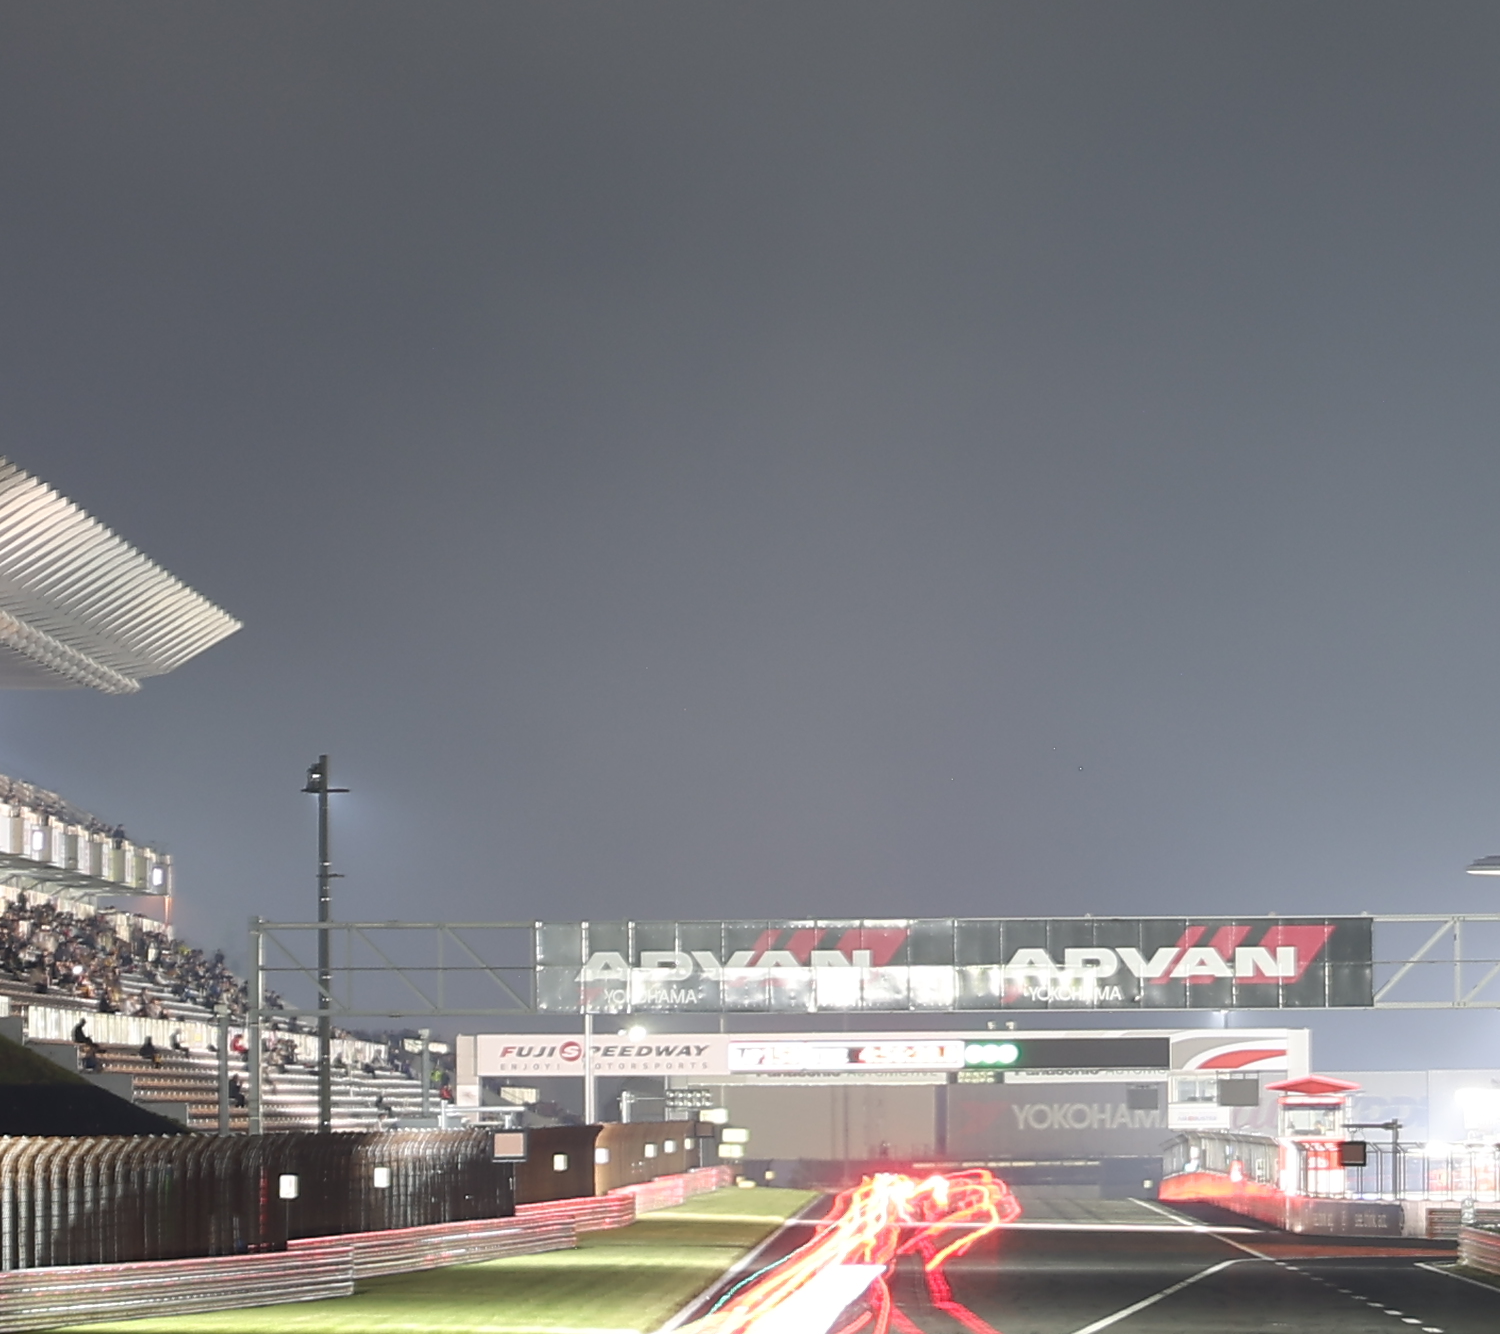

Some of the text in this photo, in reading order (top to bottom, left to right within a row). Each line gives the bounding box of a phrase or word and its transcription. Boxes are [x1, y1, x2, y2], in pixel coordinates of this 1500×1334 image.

[1003, 946, 1297, 979] ADVAN
[499, 1045, 557, 1058] FUJI
[500, 1063, 561, 1071] ENJOY!
